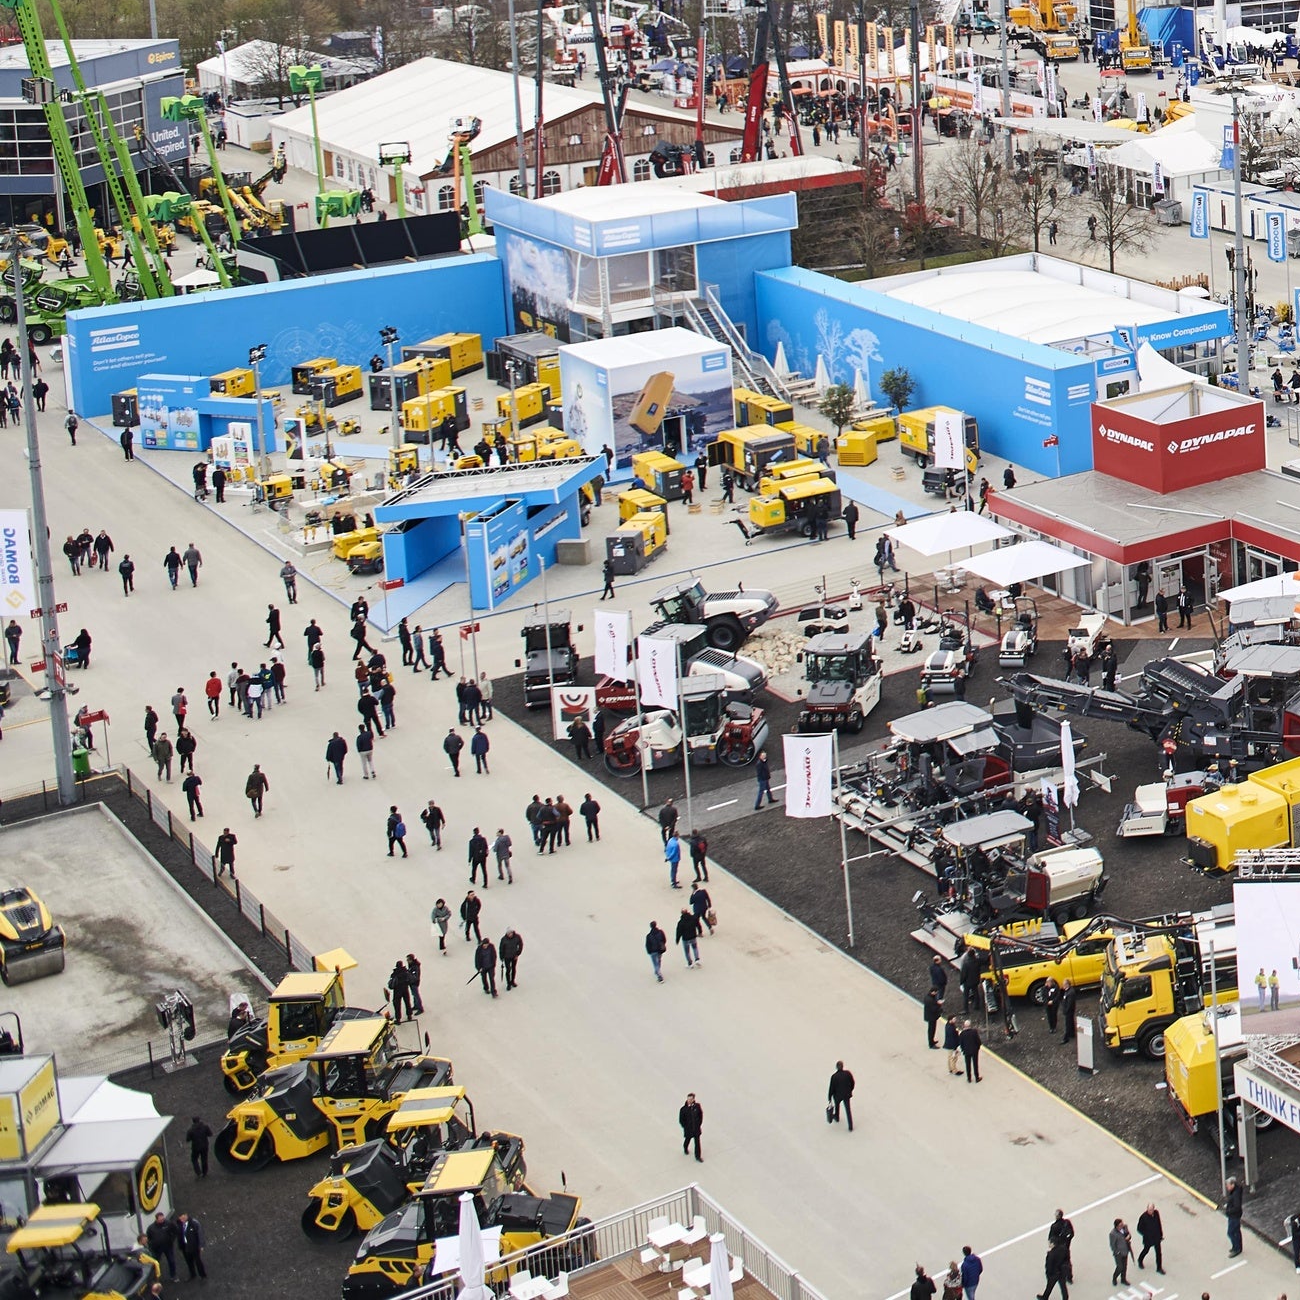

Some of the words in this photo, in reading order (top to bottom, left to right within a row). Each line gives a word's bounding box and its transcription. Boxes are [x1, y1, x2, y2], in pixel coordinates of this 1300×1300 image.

[152, 127, 180, 144] United.
[1150, 329, 1174, 341] Know
[1174, 321, 1219, 337] Compaction
[1107, 429, 1153, 452] DYNAPAC
[1179, 423, 1254, 448] DYNAPAC
[1000, 917, 1043, 939] NEW
[1244, 1077, 1286, 1121] THINK
